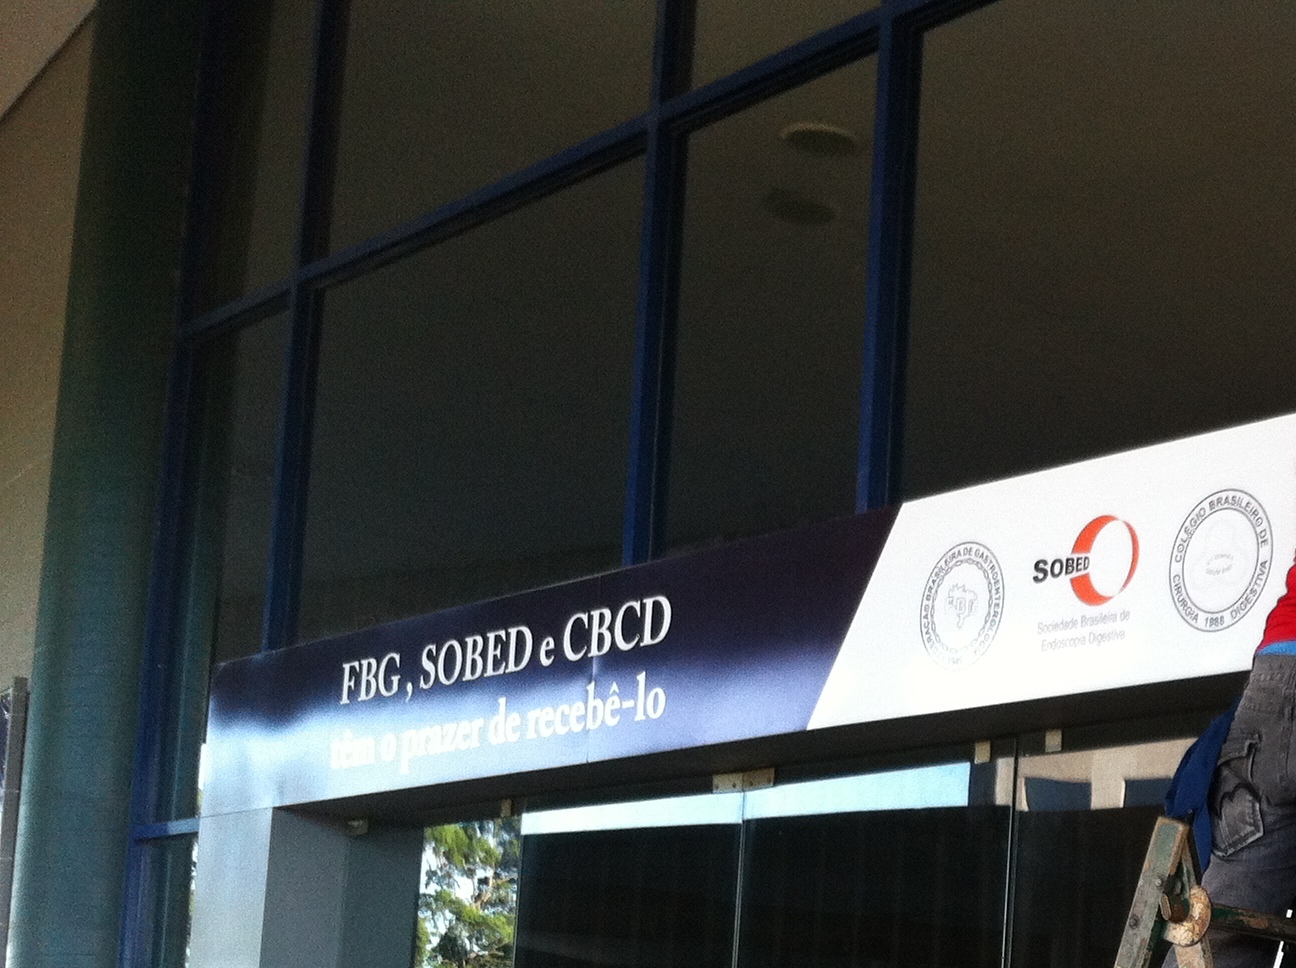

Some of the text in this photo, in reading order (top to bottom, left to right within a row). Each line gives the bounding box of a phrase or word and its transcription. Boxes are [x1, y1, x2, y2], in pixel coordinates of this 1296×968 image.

[1259, 529, 1269, 548] DE
[1032, 556, 1090, 584] SOBED
[1230, 559, 1268, 620] DIGESTIVA
[1037, 609, 1130, 635] Sociedade Brasileira de
[419, 625, 533, 690] SOBED
[540, 637, 555, 667] e
[563, 595, 672, 662] CBCD
[1089, 629, 1125, 647] Digestiva
[380, 732, 397, 761] o
[400, 718, 484, 774] prazer
[488, 696, 521, 746] de
[527, 670, 666, 739] recebê-lo
